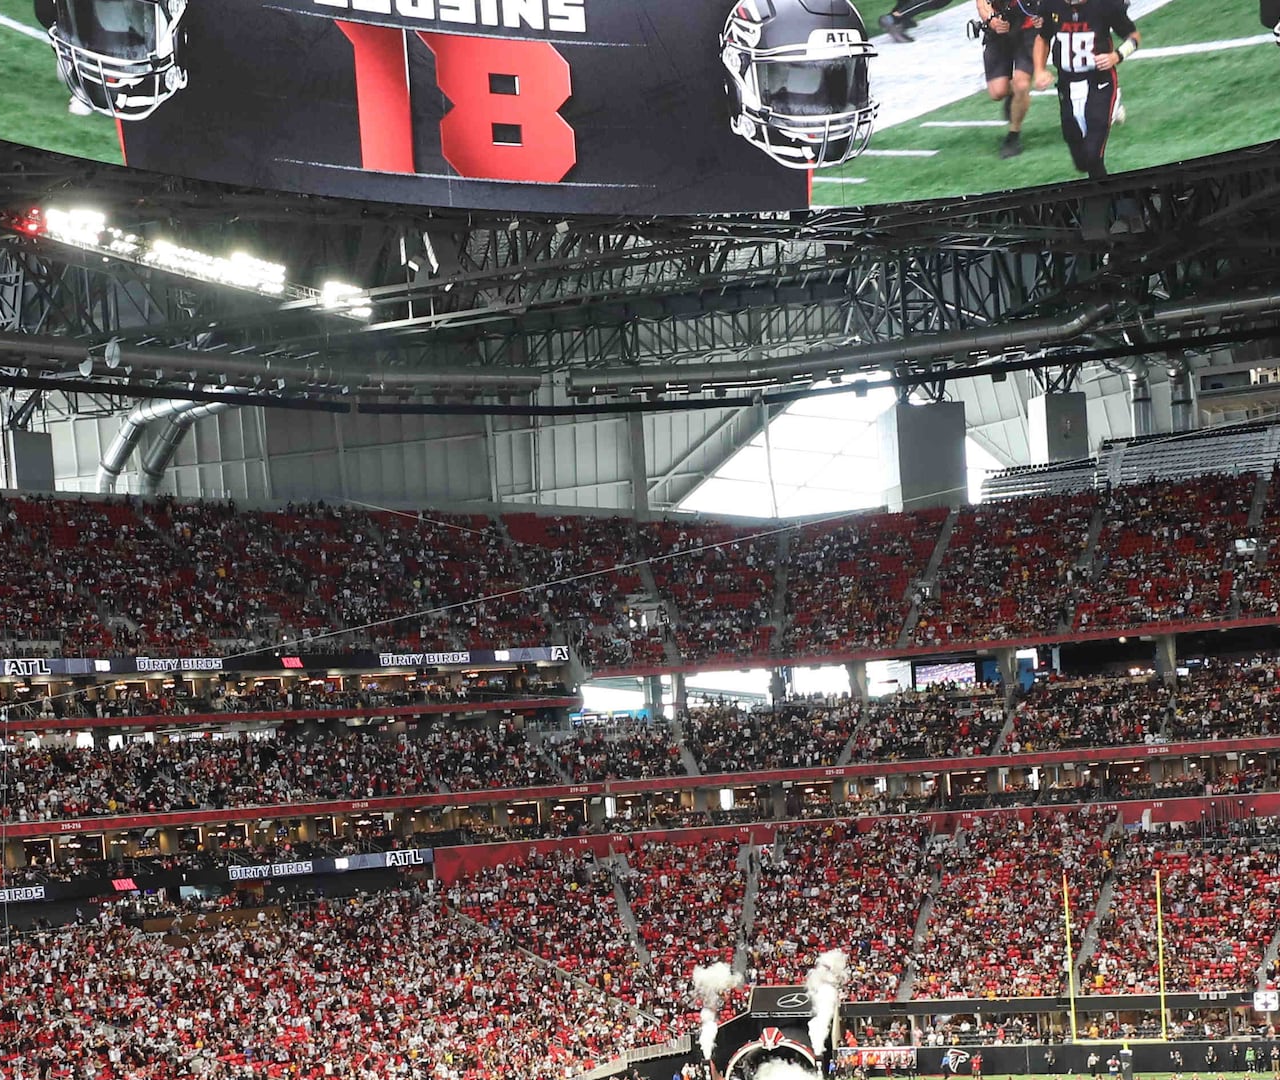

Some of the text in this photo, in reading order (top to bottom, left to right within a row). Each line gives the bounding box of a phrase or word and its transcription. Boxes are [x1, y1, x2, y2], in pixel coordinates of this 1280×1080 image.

[826, 32, 854, 43] ATL
[1056, 31, 1097, 72] 18
[334, 20, 574, 183] 18
[4, 658, 52, 675] ATL
[136, 657, 222, 671] DIRTY BIRDS
[380, 652, 469, 666] DIRTY BIRDS
[386, 850, 423, 866] ATL
[228, 861, 313, 881] DIRTY BIRDS
[112, 878, 137, 891] KIRK
